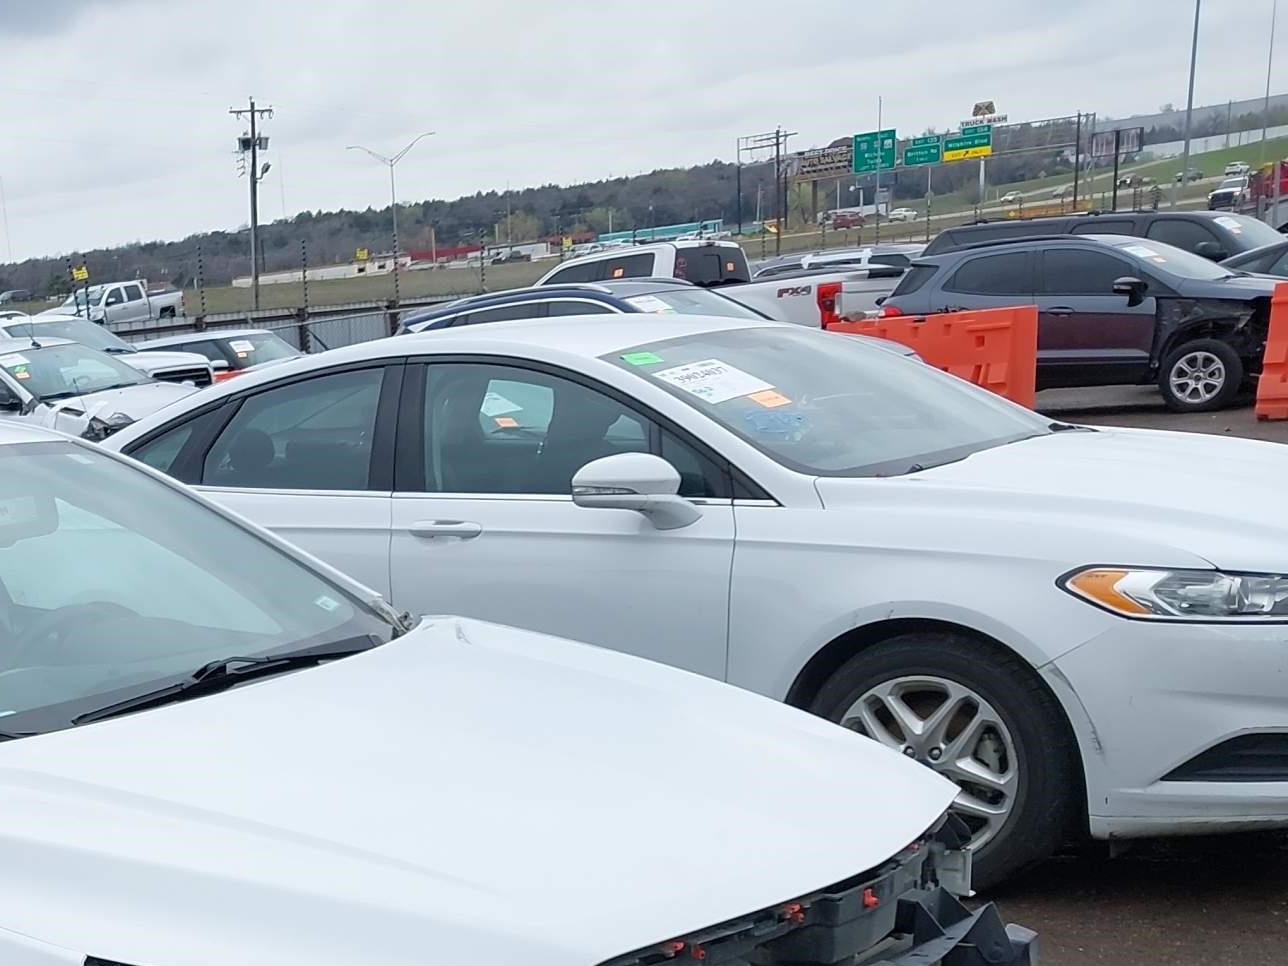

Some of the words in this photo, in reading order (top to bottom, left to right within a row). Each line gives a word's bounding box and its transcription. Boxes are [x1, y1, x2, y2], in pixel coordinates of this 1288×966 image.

[961, 118, 984, 128] TRUCK
[987, 113, 1008, 124] WASH
[777, 285, 812, 298] FX4
